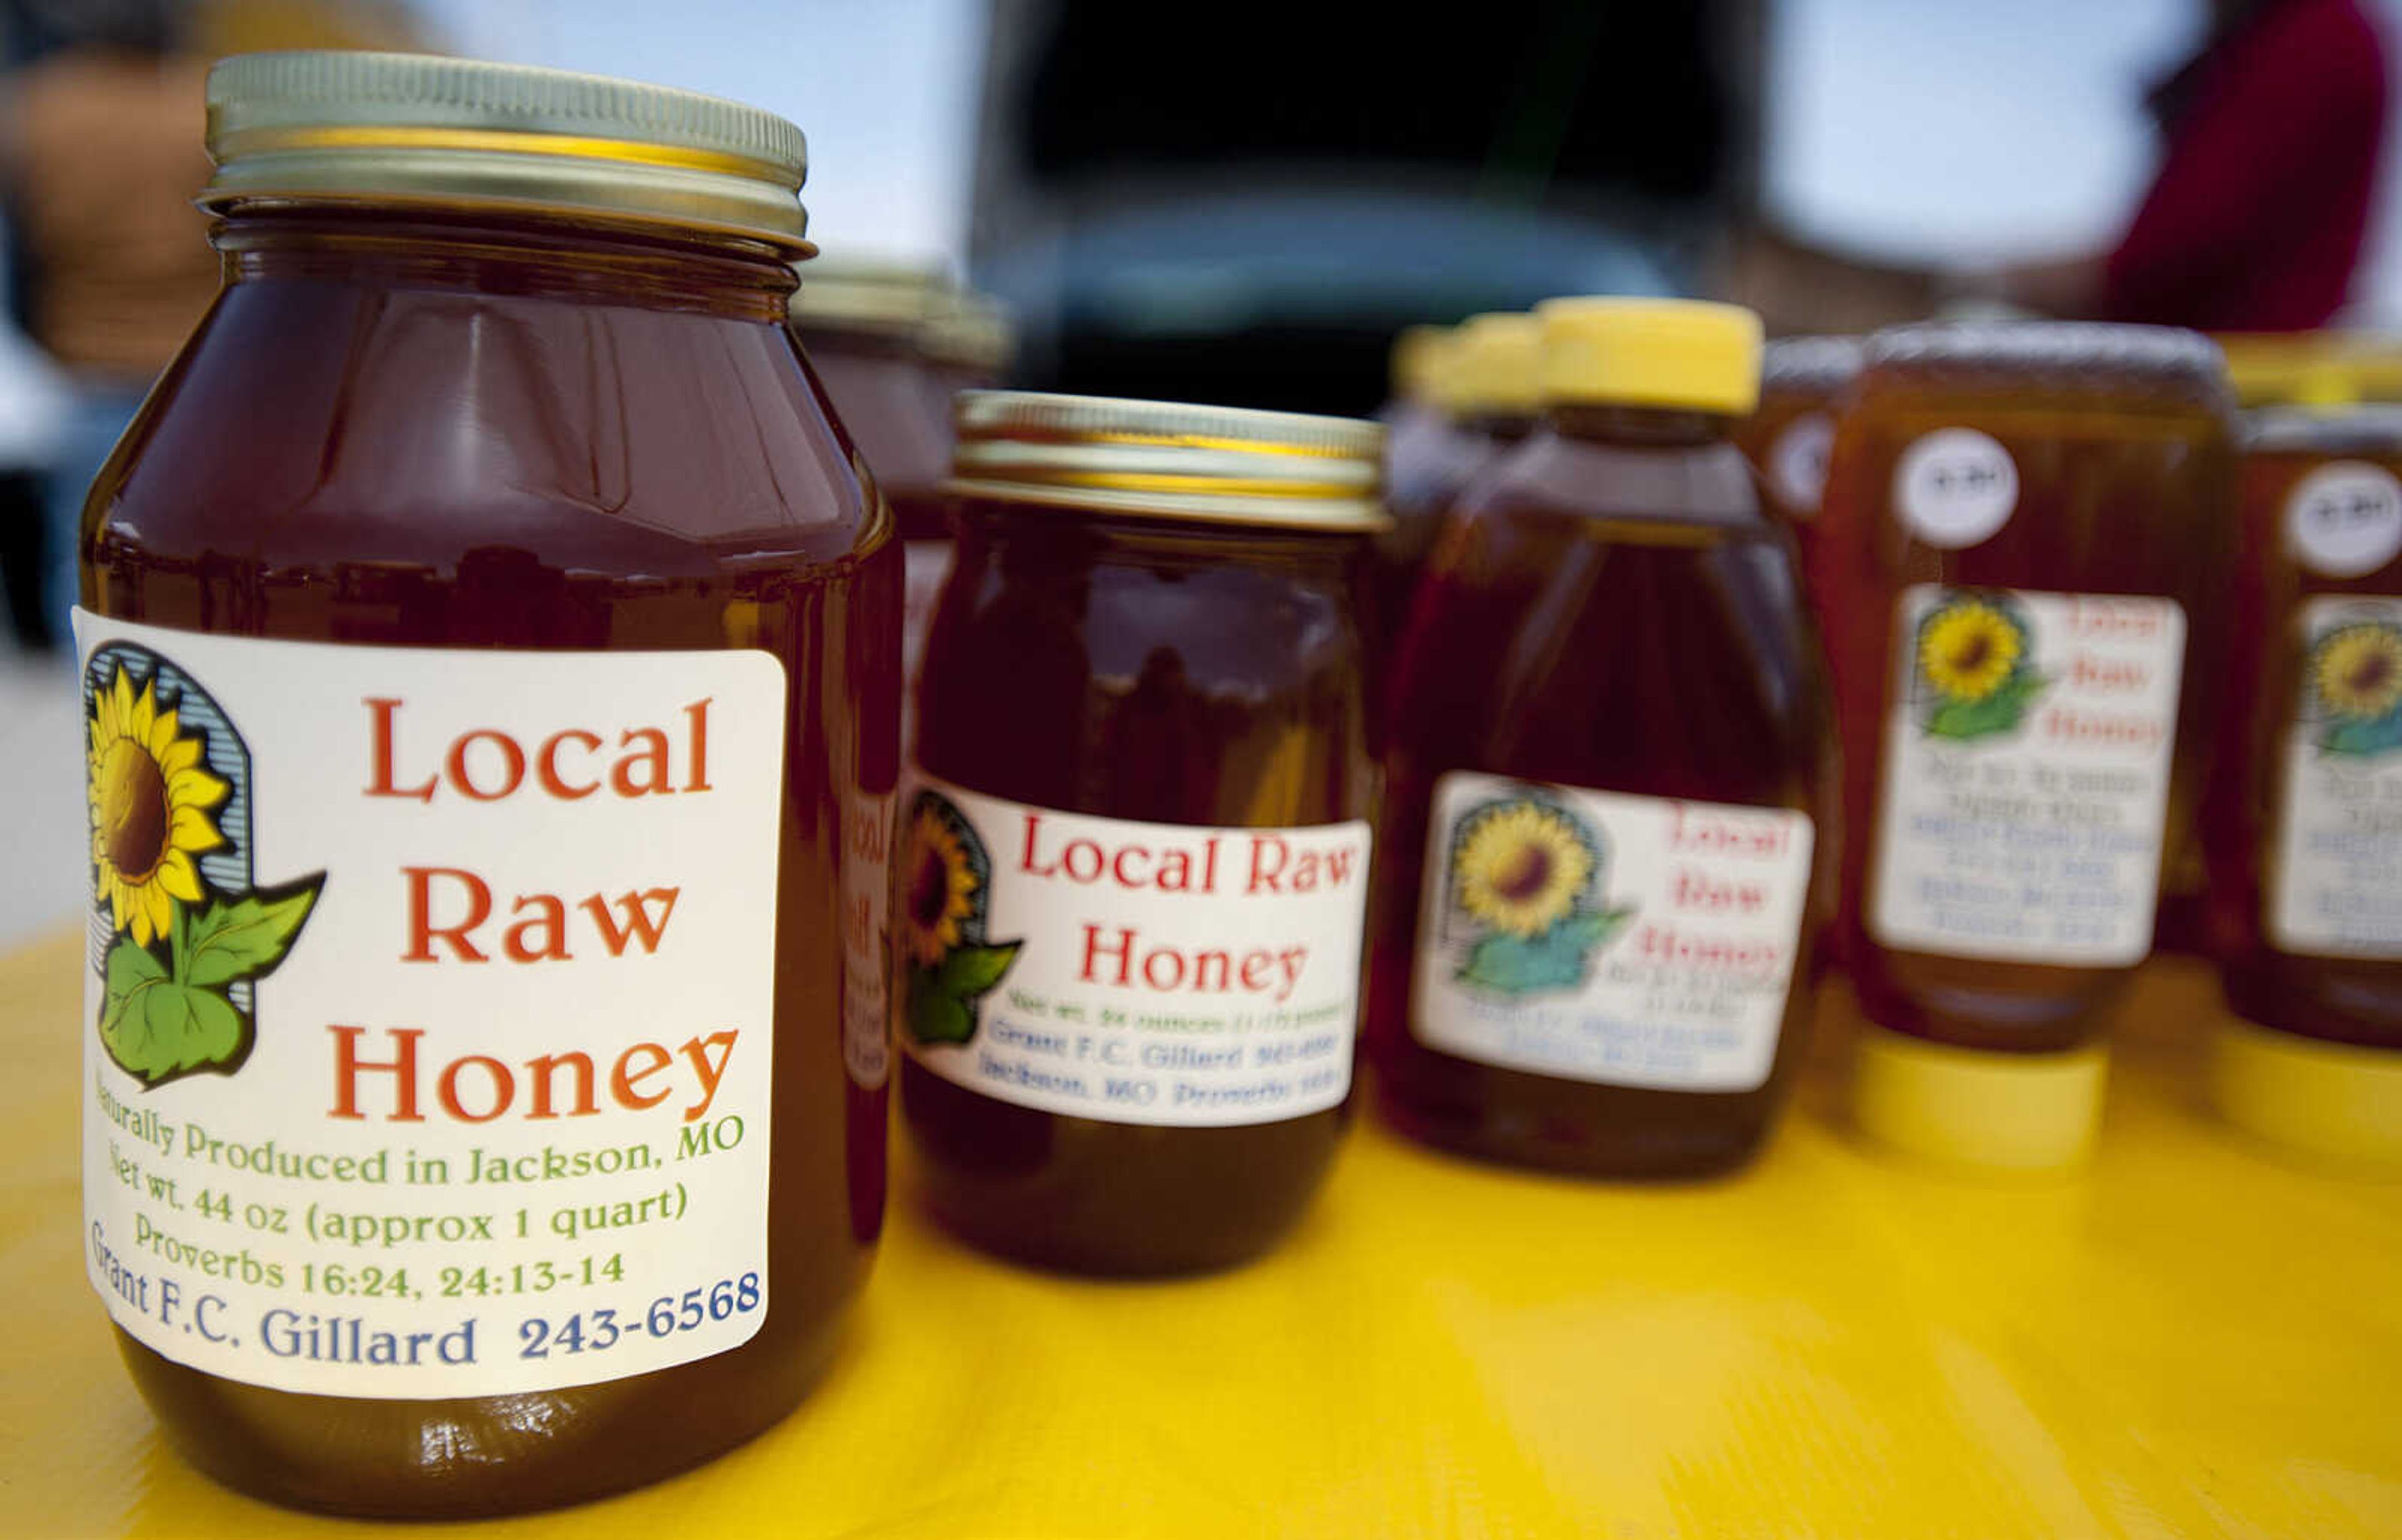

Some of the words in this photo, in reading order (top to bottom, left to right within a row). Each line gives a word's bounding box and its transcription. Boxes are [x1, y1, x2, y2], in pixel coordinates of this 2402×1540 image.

[362, 696, 712, 804] Local
[1018, 812, 1221, 894] Local
[1245, 831, 1356, 895] Raw
[400, 866, 681, 965] Raw
[1075, 922, 1309, 1003] Honey
[326, 1024, 739, 1124] Honey
[185, 1123, 389, 1185] Produced
[405, 1150, 449, 1185] in
[465, 1143, 662, 1185] Jackson,
[676, 1115, 744, 1161] MO
[146, 1173, 185, 1211] wt.
[193, 1188, 233, 1222] 44
[245, 1204, 289, 1234] oz
[306, 1202, 494, 1248] (approx
[515, 1208, 530, 1239] 1
[550, 1182, 688, 1240] quart)
[91, 1220, 149, 1314] Grant
[159, 1278, 240, 1349] F.C.
[260, 1308, 478, 1366] Gillard
[519, 1271, 761, 1360] 243-6568
[134, 1212, 286, 1289] Proverbs
[302, 1264, 423, 1302] 16:24,
[440, 1253, 626, 1299] 24:13-14
